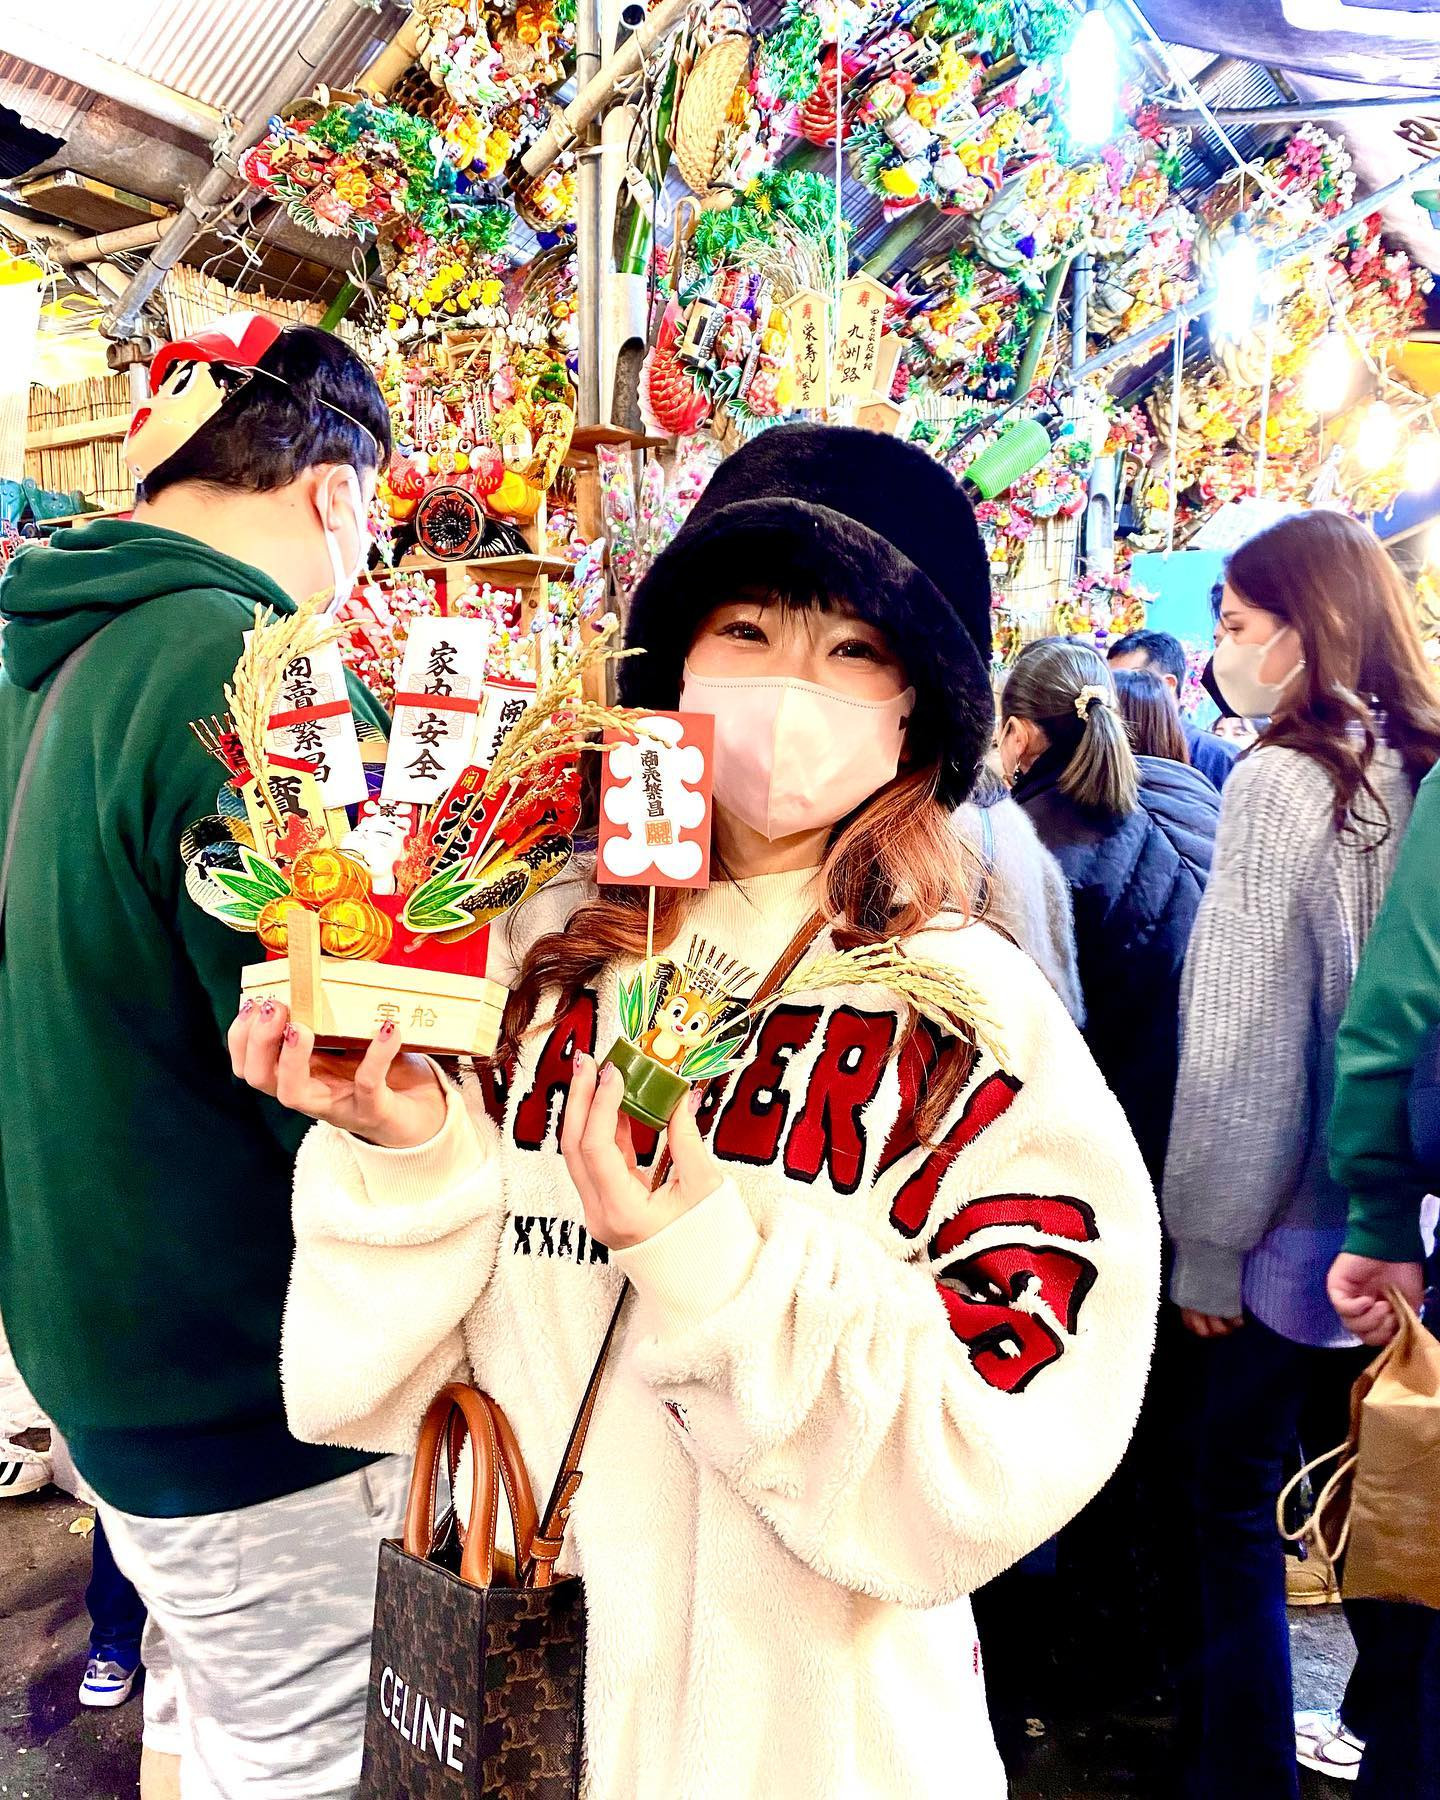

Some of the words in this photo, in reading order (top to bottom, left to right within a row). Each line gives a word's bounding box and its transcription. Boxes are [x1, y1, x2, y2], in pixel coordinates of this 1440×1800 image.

[841, 324, 864, 384] 九州路
[404, 641, 458, 780] 家内安全
[376, 1002, 438, 1029] 宝船
[380, 1665, 466, 1773] CELINE
